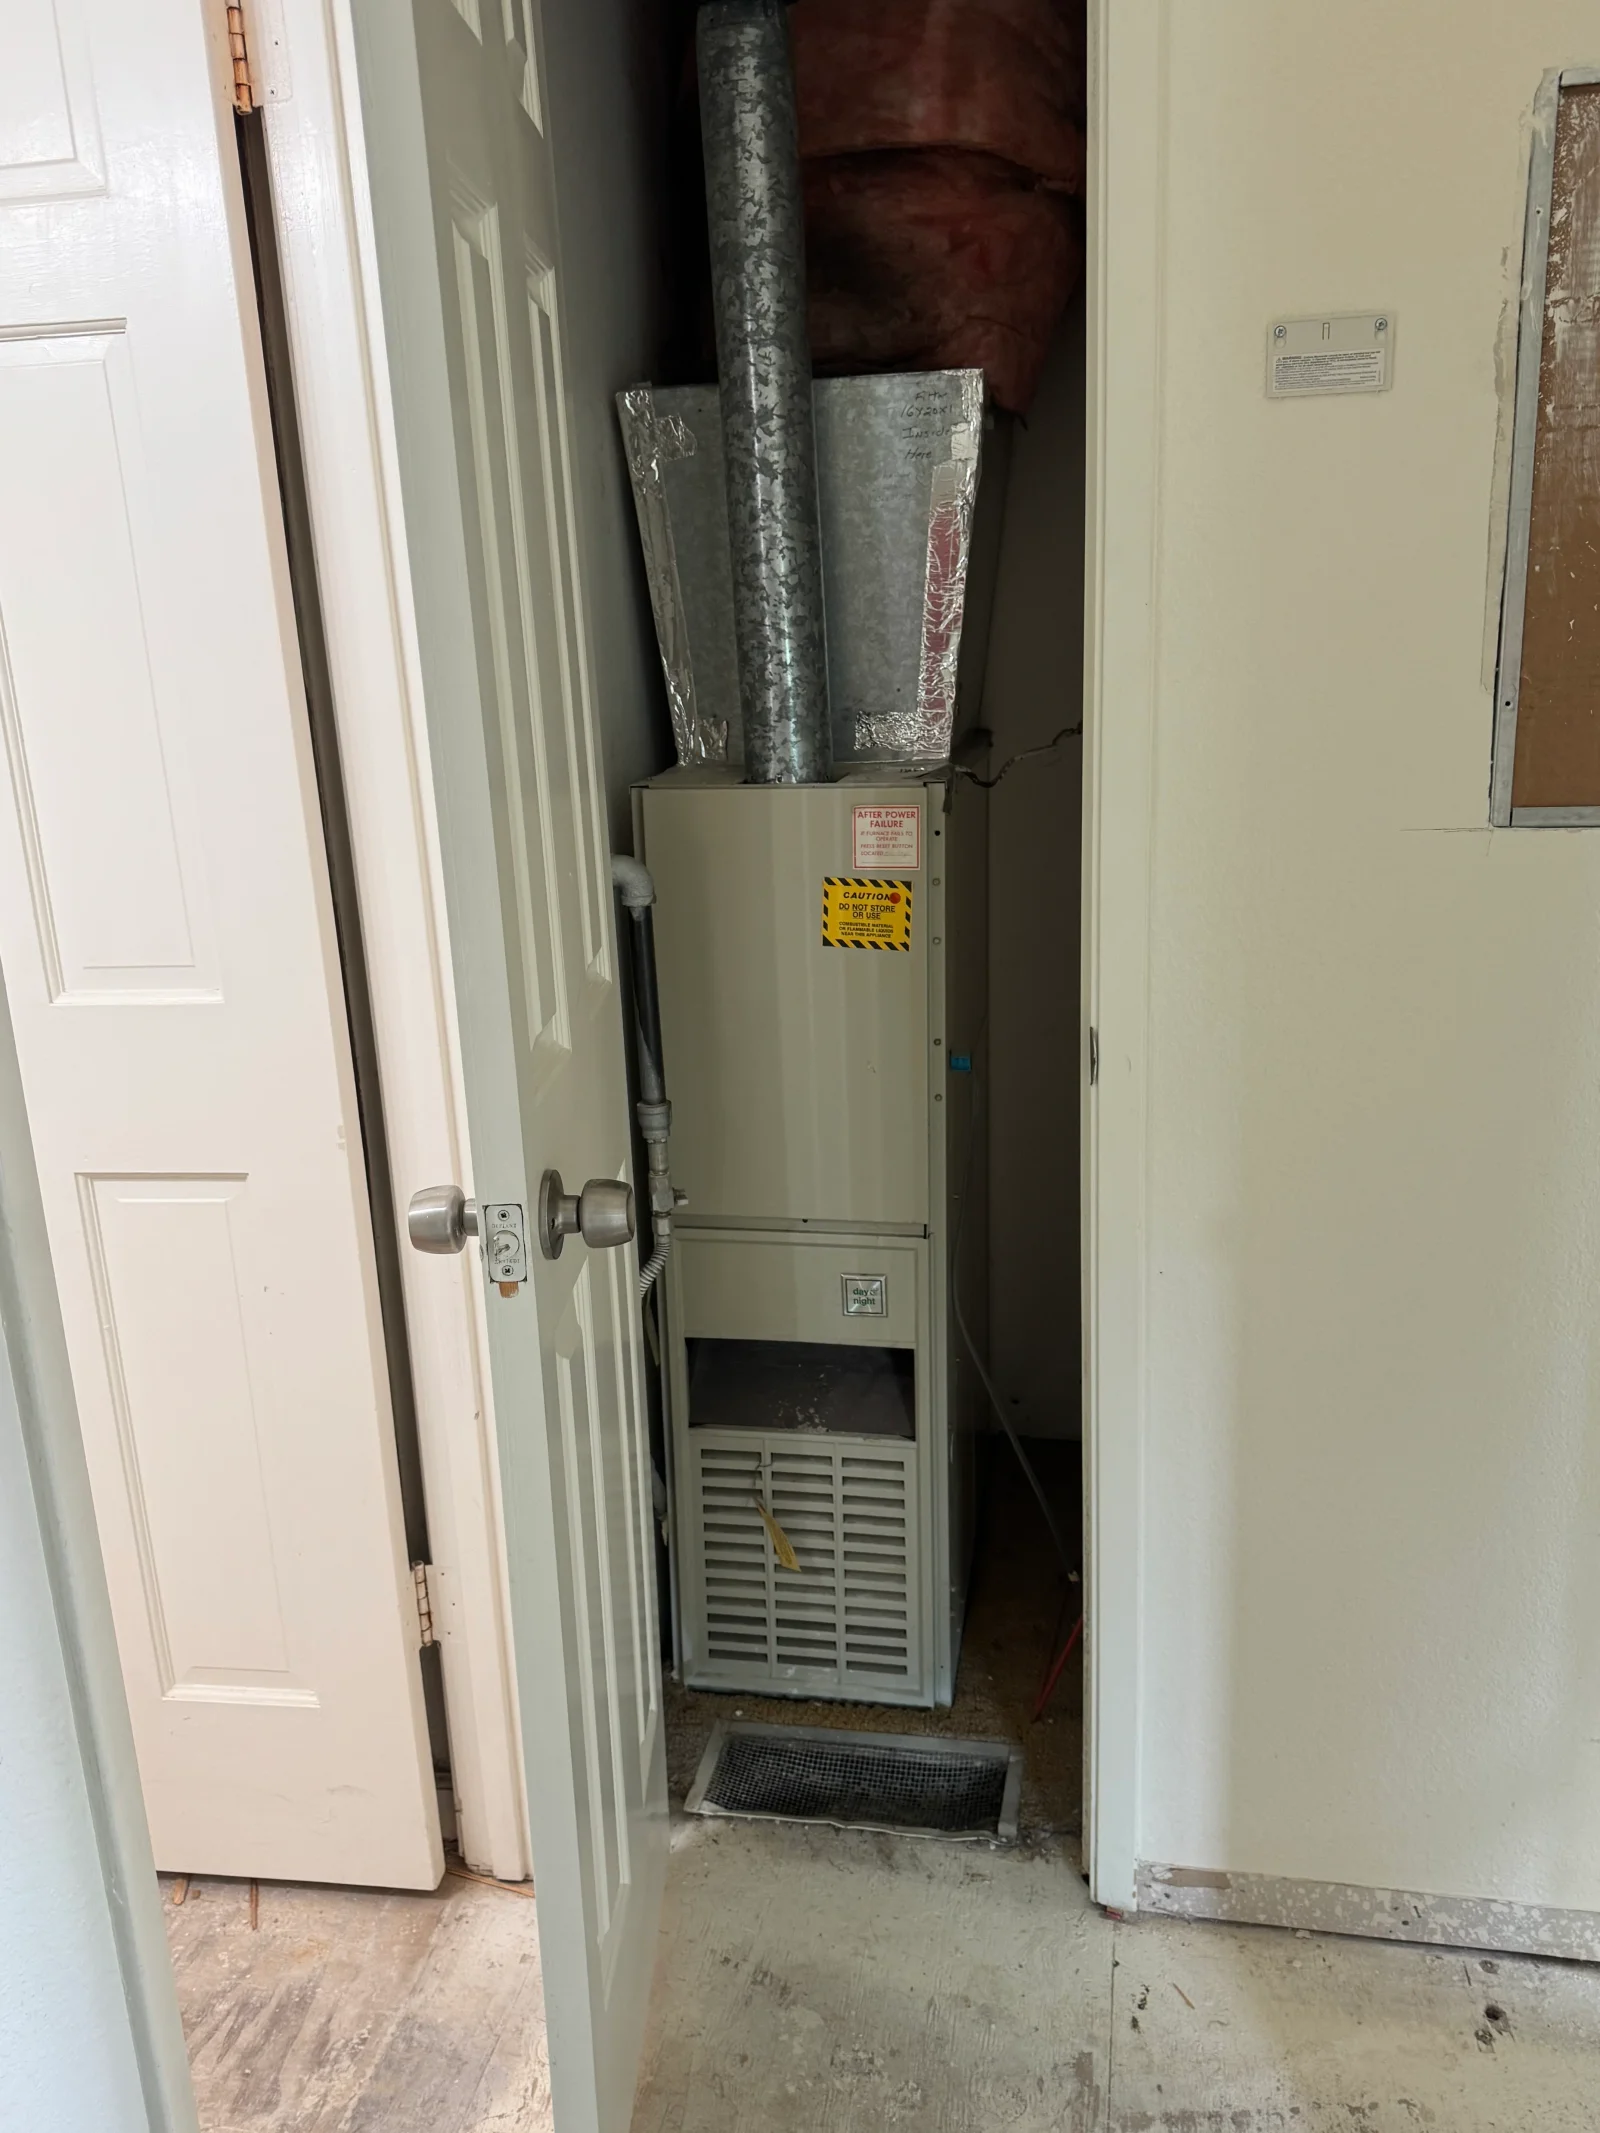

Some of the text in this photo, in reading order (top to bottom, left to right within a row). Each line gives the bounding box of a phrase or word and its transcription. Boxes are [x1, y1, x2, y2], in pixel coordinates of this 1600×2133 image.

[904, 447, 932, 459] Here
[857, 811, 916, 819] AFTER POWER
[870, 820, 904, 828] FAILURE
[843, 892, 891, 901] CAUTION
[870, 904, 896, 912] STORE
[853, 1288, 869, 1296] day
[853, 1297, 875, 1306] night
